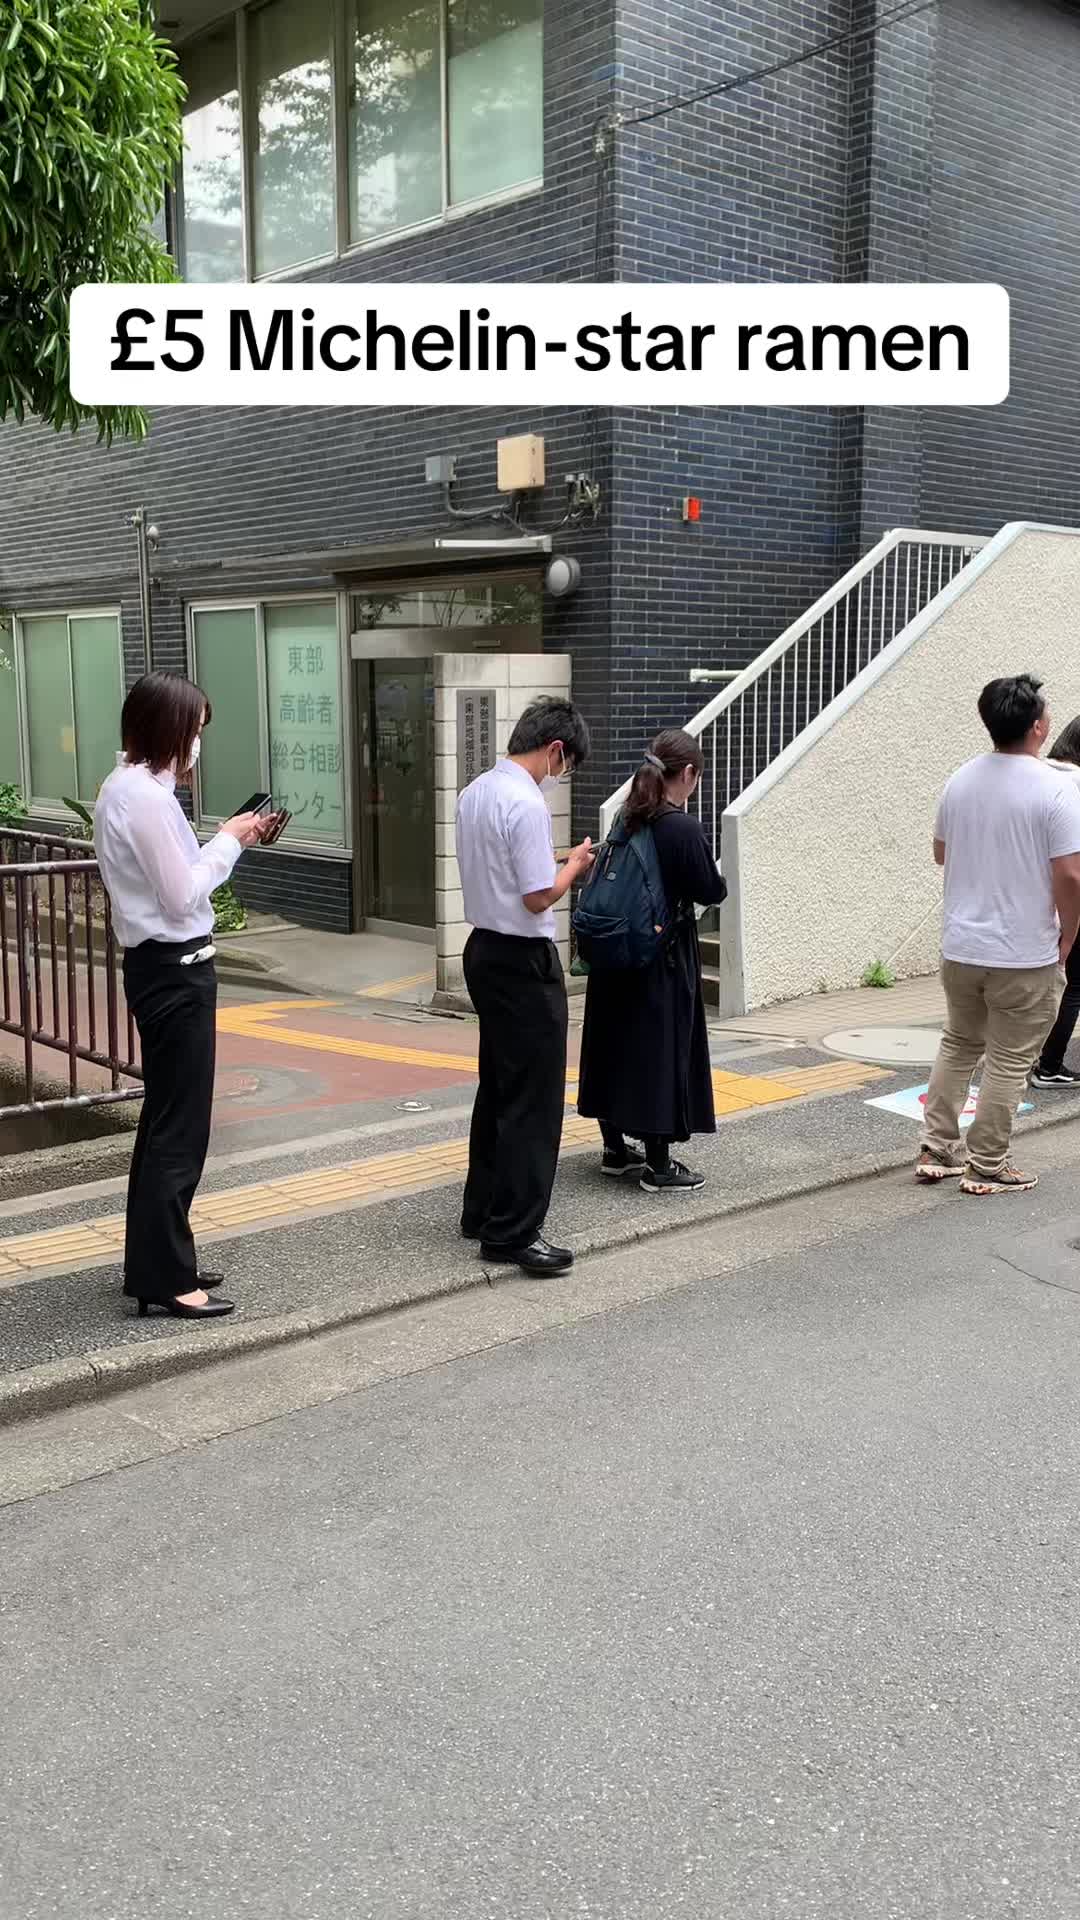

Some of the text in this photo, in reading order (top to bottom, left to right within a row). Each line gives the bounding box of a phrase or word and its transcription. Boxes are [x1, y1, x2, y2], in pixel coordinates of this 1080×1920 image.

[288, 644, 324, 676] 東部
[279, 692, 335, 726] 高齢者
[272, 740, 342, 774] 総合相談
[273, 787, 342, 820] センター
